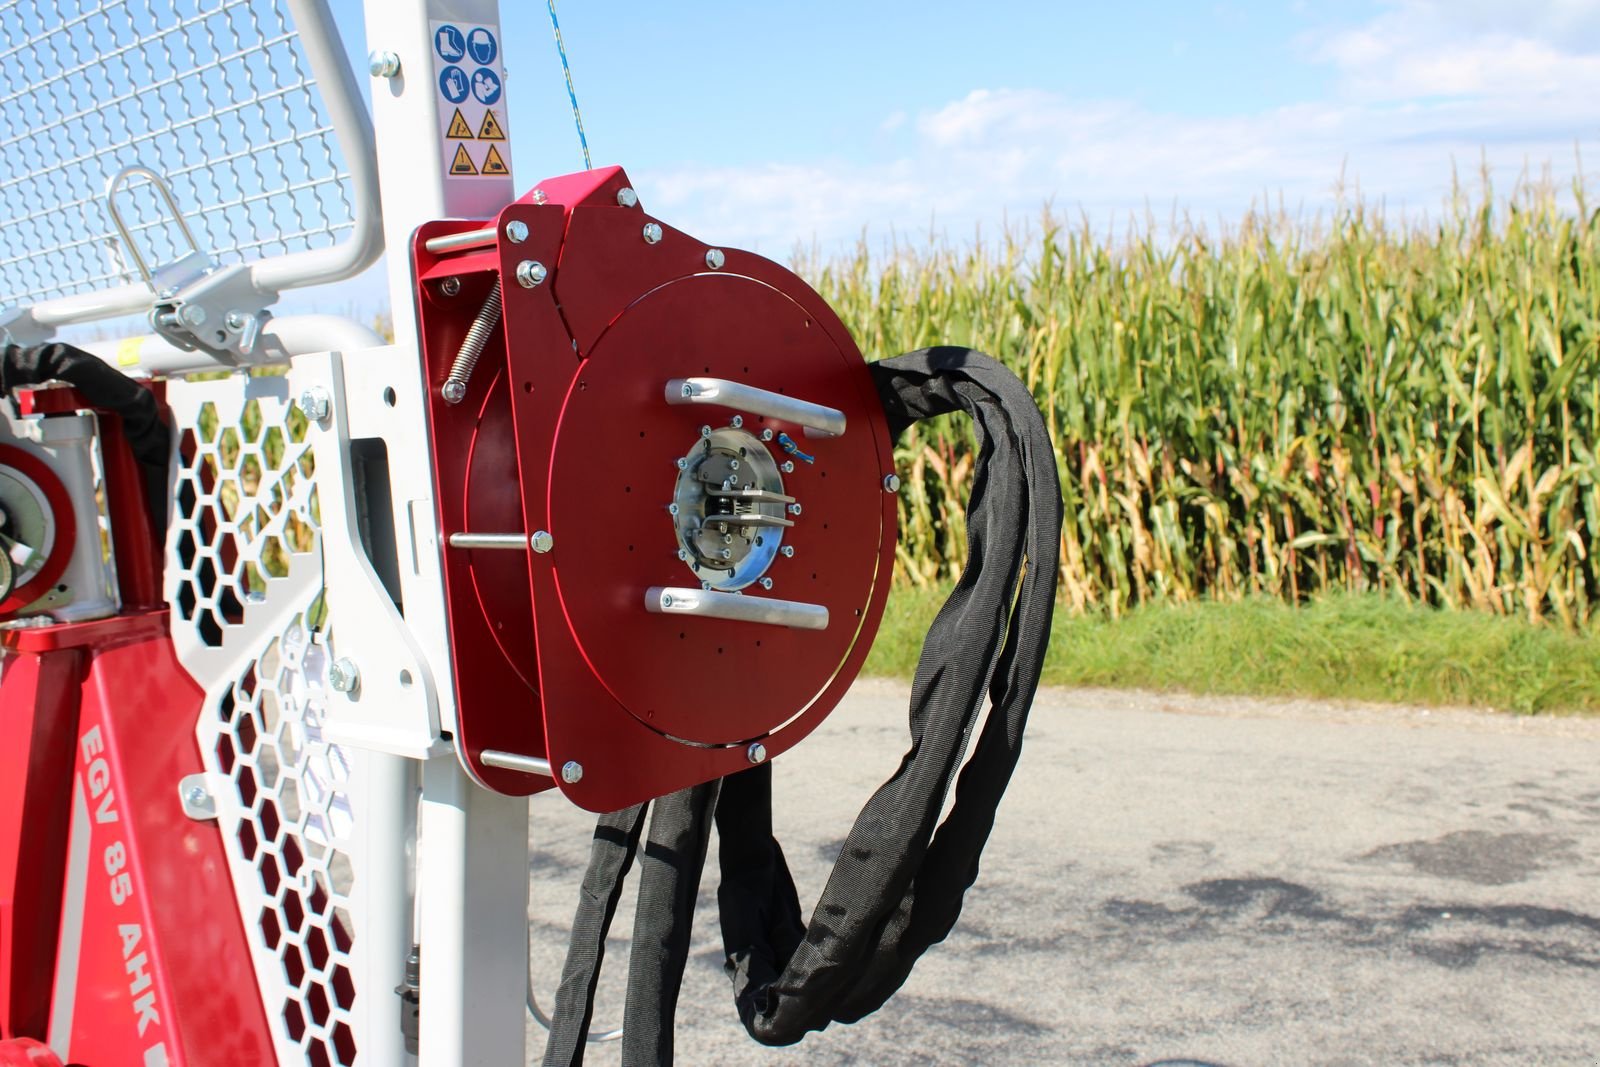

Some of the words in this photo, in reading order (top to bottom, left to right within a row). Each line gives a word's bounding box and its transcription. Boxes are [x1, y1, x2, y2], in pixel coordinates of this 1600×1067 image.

[81, 726, 118, 824] EGV
[104, 841, 134, 906] 85
[118, 923, 160, 1038] AHK
